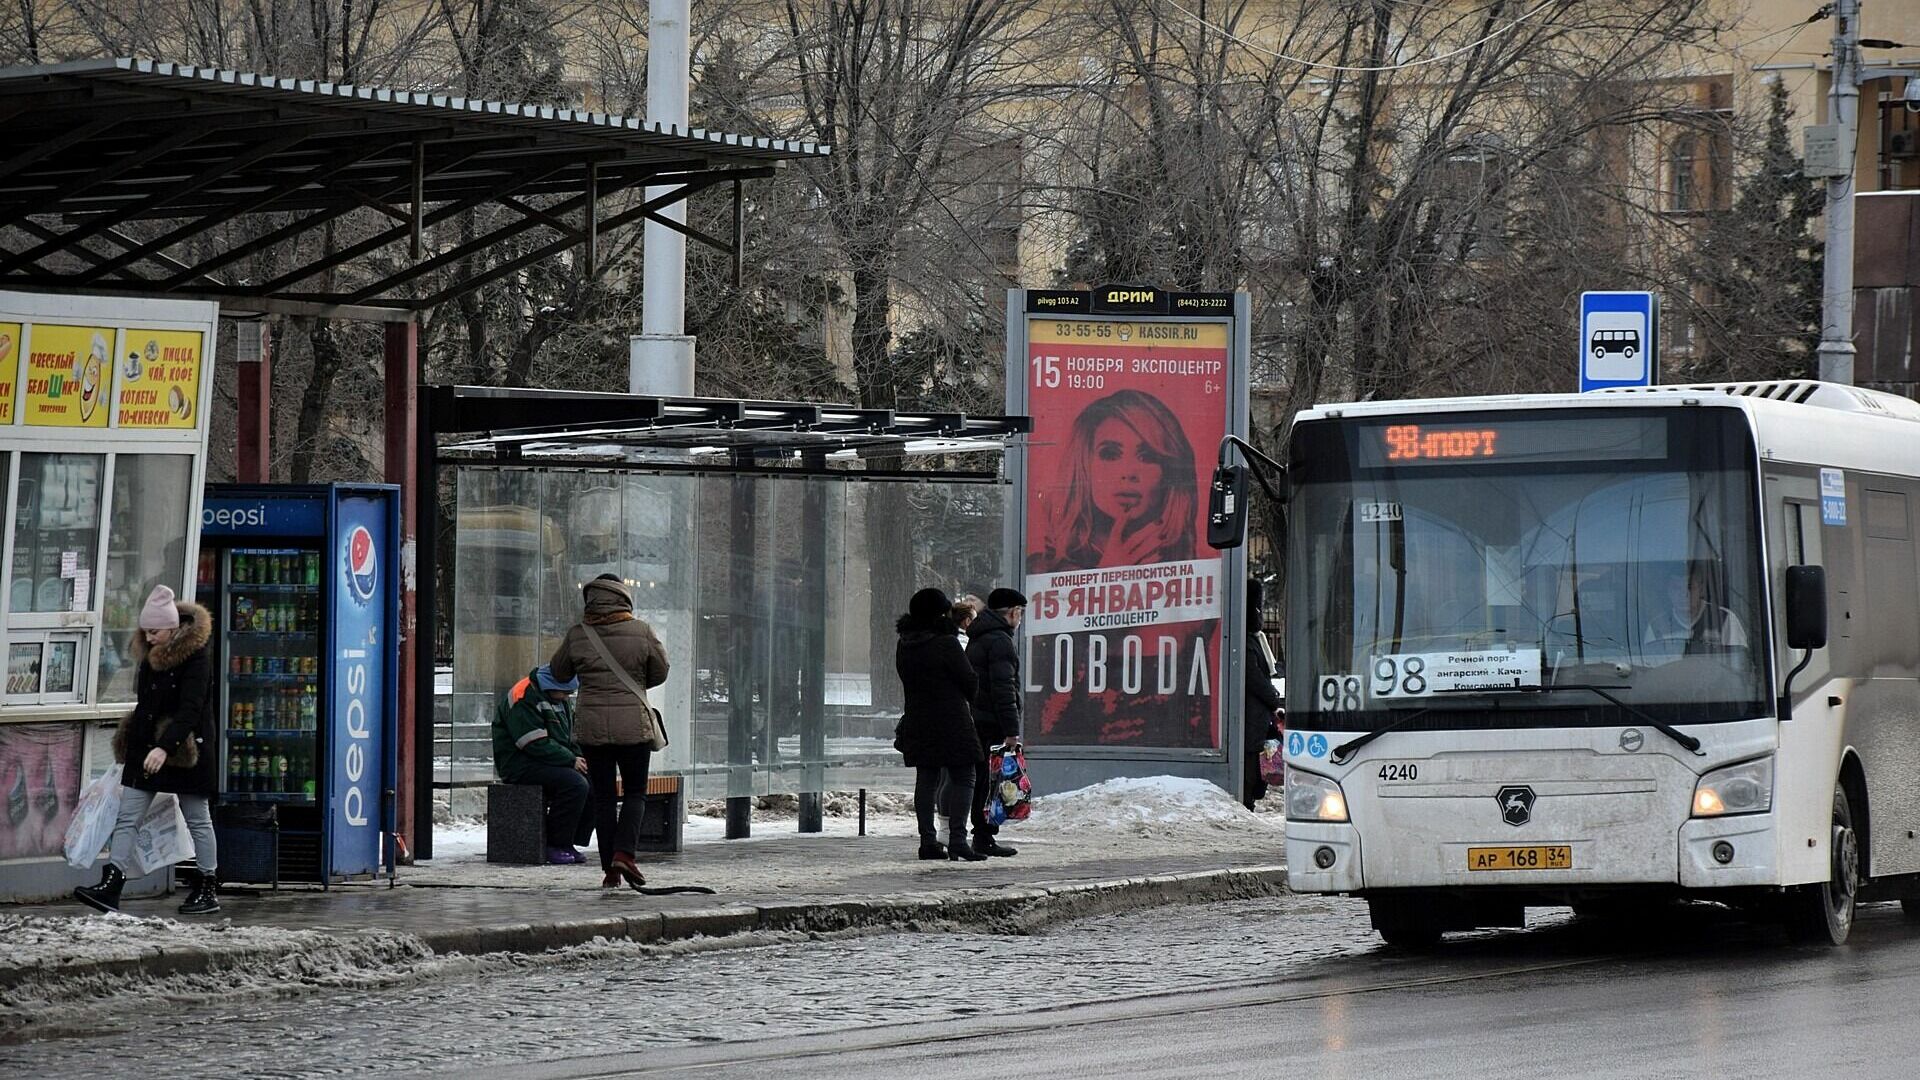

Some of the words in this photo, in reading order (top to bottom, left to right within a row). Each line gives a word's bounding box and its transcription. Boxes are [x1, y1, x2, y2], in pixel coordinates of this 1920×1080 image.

[1057, 297, 1070, 305] 103
[1107, 291, 1154, 303] ДРИМ
[1177, 299, 1199, 308] (8442)
[1200, 299, 1227, 307] 25-2222
[1139, 326, 1198, 340] KASSIR.RU
[163, 347, 194, 364] ПИЦЦА,
[148, 364, 167, 383] ЧАЙ,
[169, 367, 193, 382] КОФЕ
[1032, 356, 1061, 388] 15
[1067, 357, 1124, 372] НОЯБРЯ
[1131, 359, 1221, 375] ЭКСПОЦЕНТР
[1067, 375, 1104, 389] 19:00
[1205, 381, 1221, 394] 6+
[120, 390, 158, 405] КОТЛЕТЫ
[118, 410, 170, 425] ПО-КИЕВСКИ
[201, 505, 265, 530] pepsi
[1361, 503, 1402, 519] 4240
[1051, 573, 1100, 588] КОНЦЕРТ
[1101, 566, 1177, 583] ПЕРЕНОСИТСЯ
[1180, 564, 1195, 576] НА
[1032, 590, 1060, 620] 15
[1067, 576, 1213, 617] ЯНВАРЯ!!!
[1083, 611, 1159, 628] ЭКСПОЦЕНТР
[1448, 655, 1484, 664] Речной
[1487, 655, 1510, 663] порт
[1374, 657, 1427, 696] 98
[1437, 668, 1489, 678] ангарский
[1497, 668, 1522, 676] Кача
[1322, 677, 1360, 711] 98
[344, 649, 369, 827] pepsi
[1378, 764, 1418, 780] 4240
[1506, 849, 1538, 867] 168
[1548, 848, 1565, 861] 34
